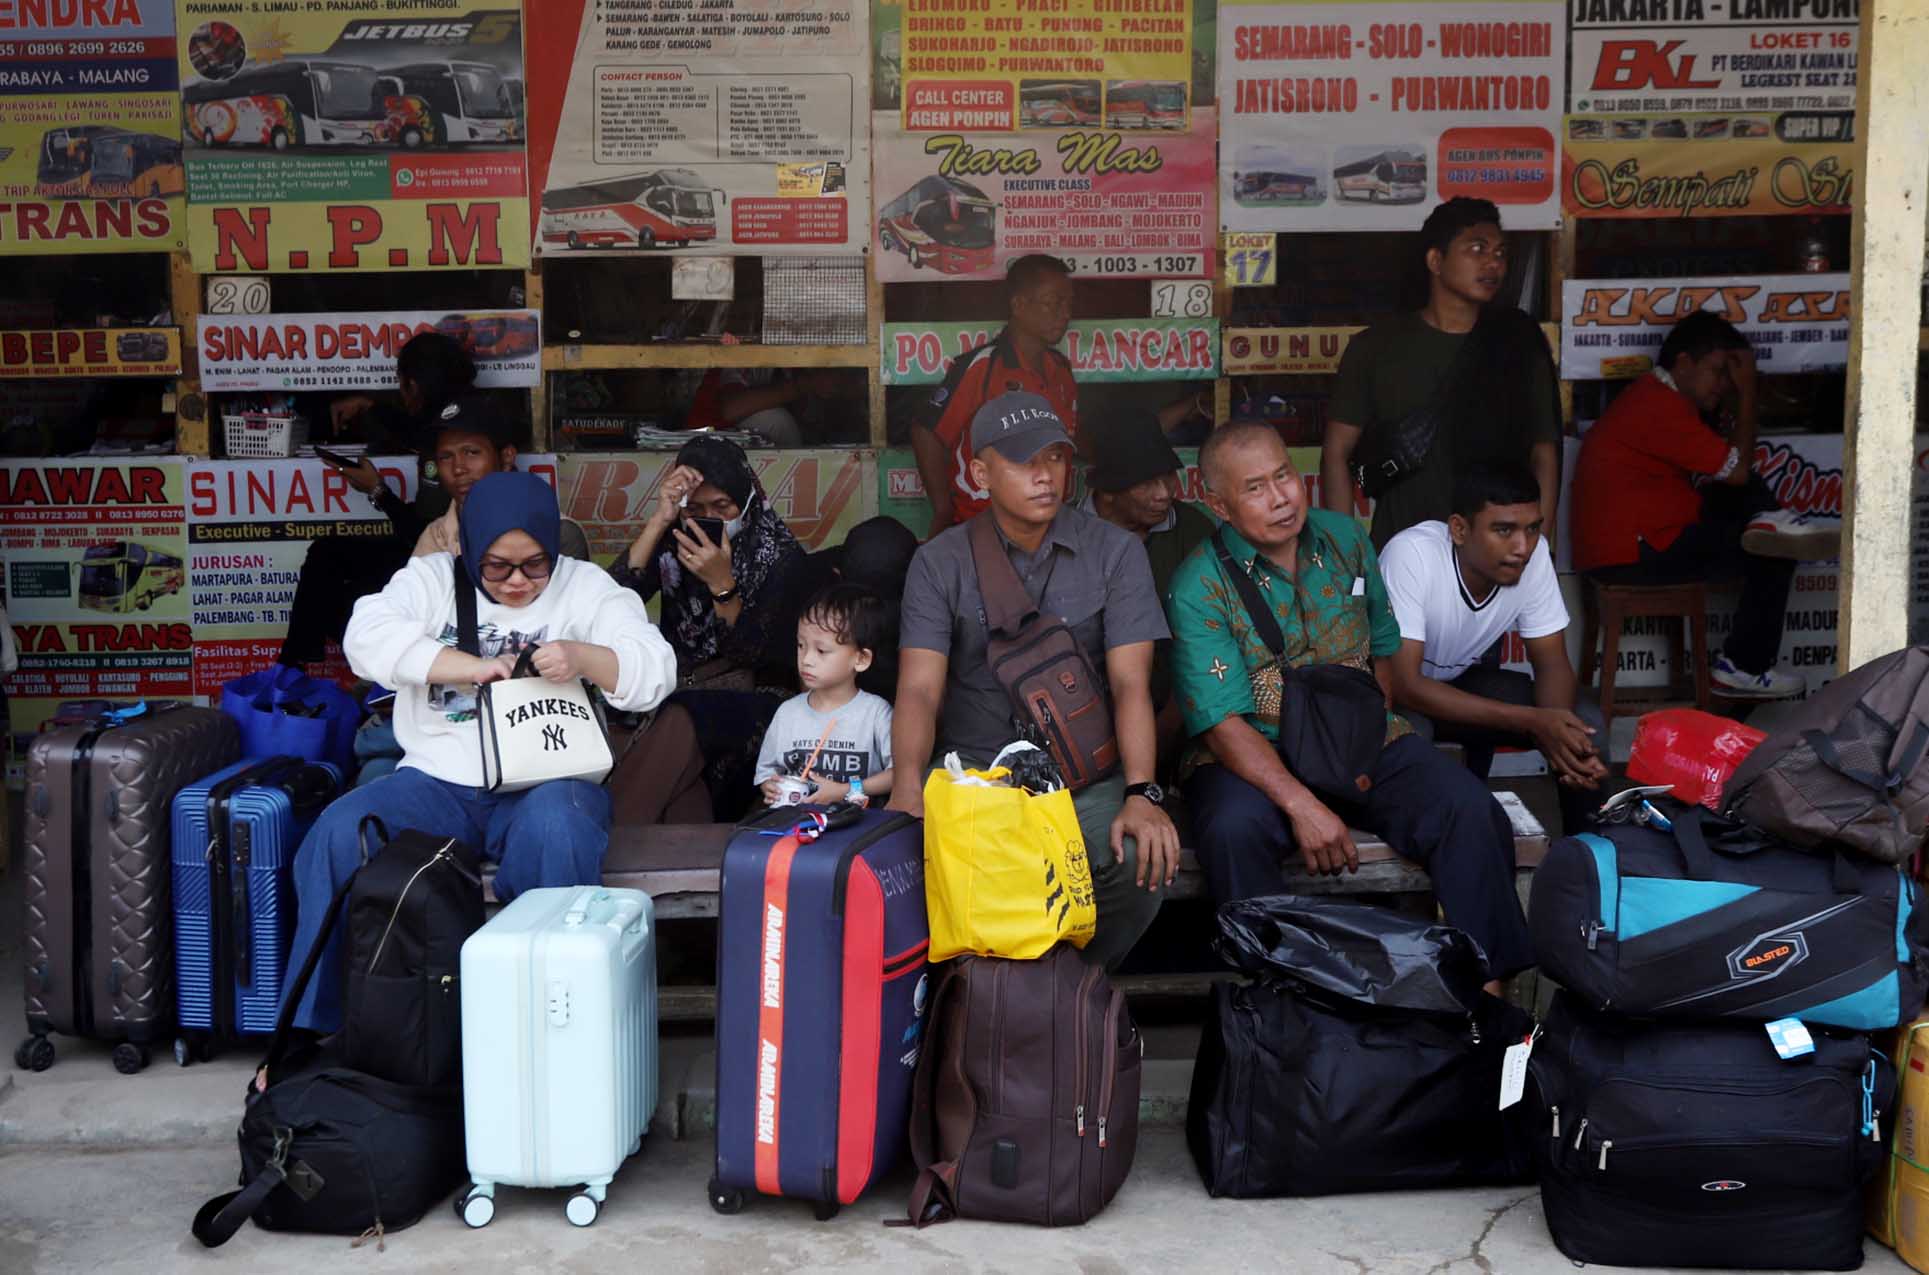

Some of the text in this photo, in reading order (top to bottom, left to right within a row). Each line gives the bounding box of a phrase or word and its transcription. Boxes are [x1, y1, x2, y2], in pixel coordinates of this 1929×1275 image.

[186, 3, 243, 13] PARIAMAN
[264, 2, 298, 12] LIMAU
[327, 0, 377, 10] PANJANG
[605, 0, 734, 9] TANGERANG CILEDUG JAKARTA
[1575, 0, 1858, 22] JAKARTA LAMPUN
[606, 14, 648, 23] SEMARANG
[687, 13, 723, 22] SALATIGA
[730, 13, 769, 22] BOYOLALI
[829, 12, 850, 21] SOLO
[343, 24, 473, 40] JETBUS
[606, 26, 831, 36] PALUR KARANGANYAR MATESIH JUMAPOLO JATIPURO
[1120, 18, 1184, 33] PACITAN
[28, 41, 144, 55] 0896 2699 2626
[606, 40, 712, 49] KARANG GEDE GEMOLONG
[908, 37, 1184, 53] SUKOHARJO JATISRONO
[1234, 23, 1552, 60] SEMARANG SOLO WONOGIRI
[1751, 32, 1851, 49] LOKET 16
[999, 57, 1104, 72] PURWANTORO
[1590, 40, 1722, 91] BKL
[1712, 53, 1844, 71] PT BERDIKARI KAWAN
[79, 68, 149, 83] MALANG
[1742, 74, 1839, 87] LEGREST SEAT
[915, 90, 1004, 105] CALL CENTER
[1233, 76, 1551, 113] JATISRONO PURWANTORO
[910, 111, 1010, 128] AGEN PONPIN
[925, 131, 1163, 176] Tiara Mas
[1004, 179, 1091, 191] EXECUTIVE CLASS
[1572, 158, 1759, 218] Sempati
[1004, 194, 1202, 209] SEMARANG SOLO NGAWI MADIUN
[1004, 214, 1201, 229] NGANJUK JOMBANG MOJOKERTO
[1004, 235, 1052, 249] SURABAYA
[1059, 234, 1098, 248] MALANG
[1131, 234, 1171, 247] LOMBOK
[1230, 236, 1271, 247] LOKET
[1093, 257, 1137, 272] 1003
[1152, 256, 1198, 272] 1307
[1232, 250, 1271, 284] 17
[211, 282, 270, 315] 20
[1154, 284, 1211, 318] 18
[205, 324, 308, 361] SINAR
[1574, 334, 1611, 347] JAKARTA
[1066, 329, 1213, 369] LANCAR
[191, 468, 350, 516] SINAR
[196, 522, 332, 546] Executive Super
[192, 555, 264, 570] JURUSAN
[192, 574, 253, 586] MARTAPURA
[193, 591, 294, 605] LAHAT PAGAR ALAM
[194, 611, 255, 624] PALEMBANG
[69, 623, 193, 652] TRANS
[194, 646, 248, 657] Fasilitas
[505, 698, 591, 728] YANKEES
[541, 723, 568, 751] NY
[828, 740, 856, 750] DENIM
